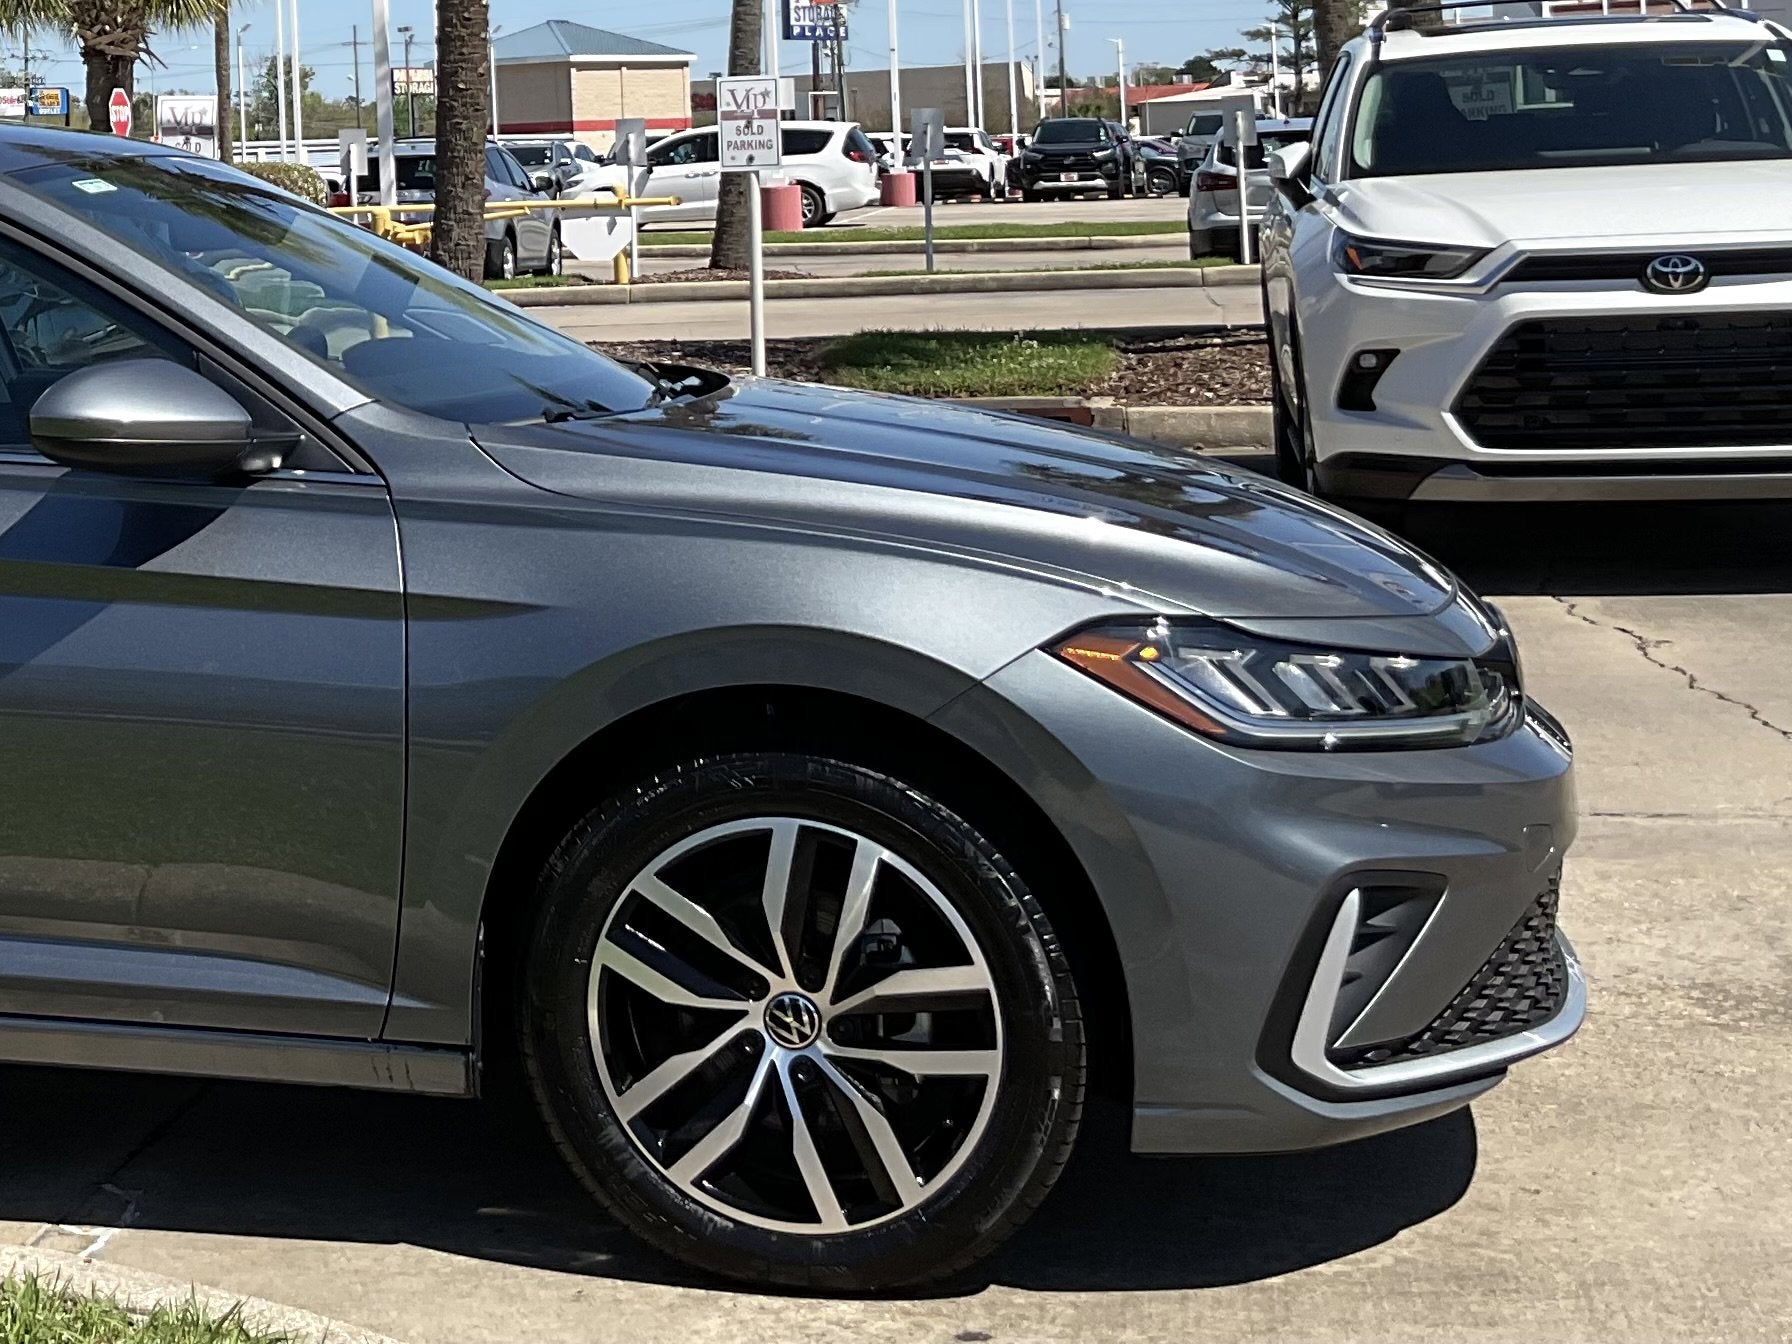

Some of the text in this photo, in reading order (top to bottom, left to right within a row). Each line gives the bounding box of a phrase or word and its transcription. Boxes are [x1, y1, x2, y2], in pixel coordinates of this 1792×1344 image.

[793, 26, 846, 37] PLACE
[111, 107, 130, 122] STOP
[735, 124, 764, 137] SOLD
[726, 139, 774, 152] PARKING
